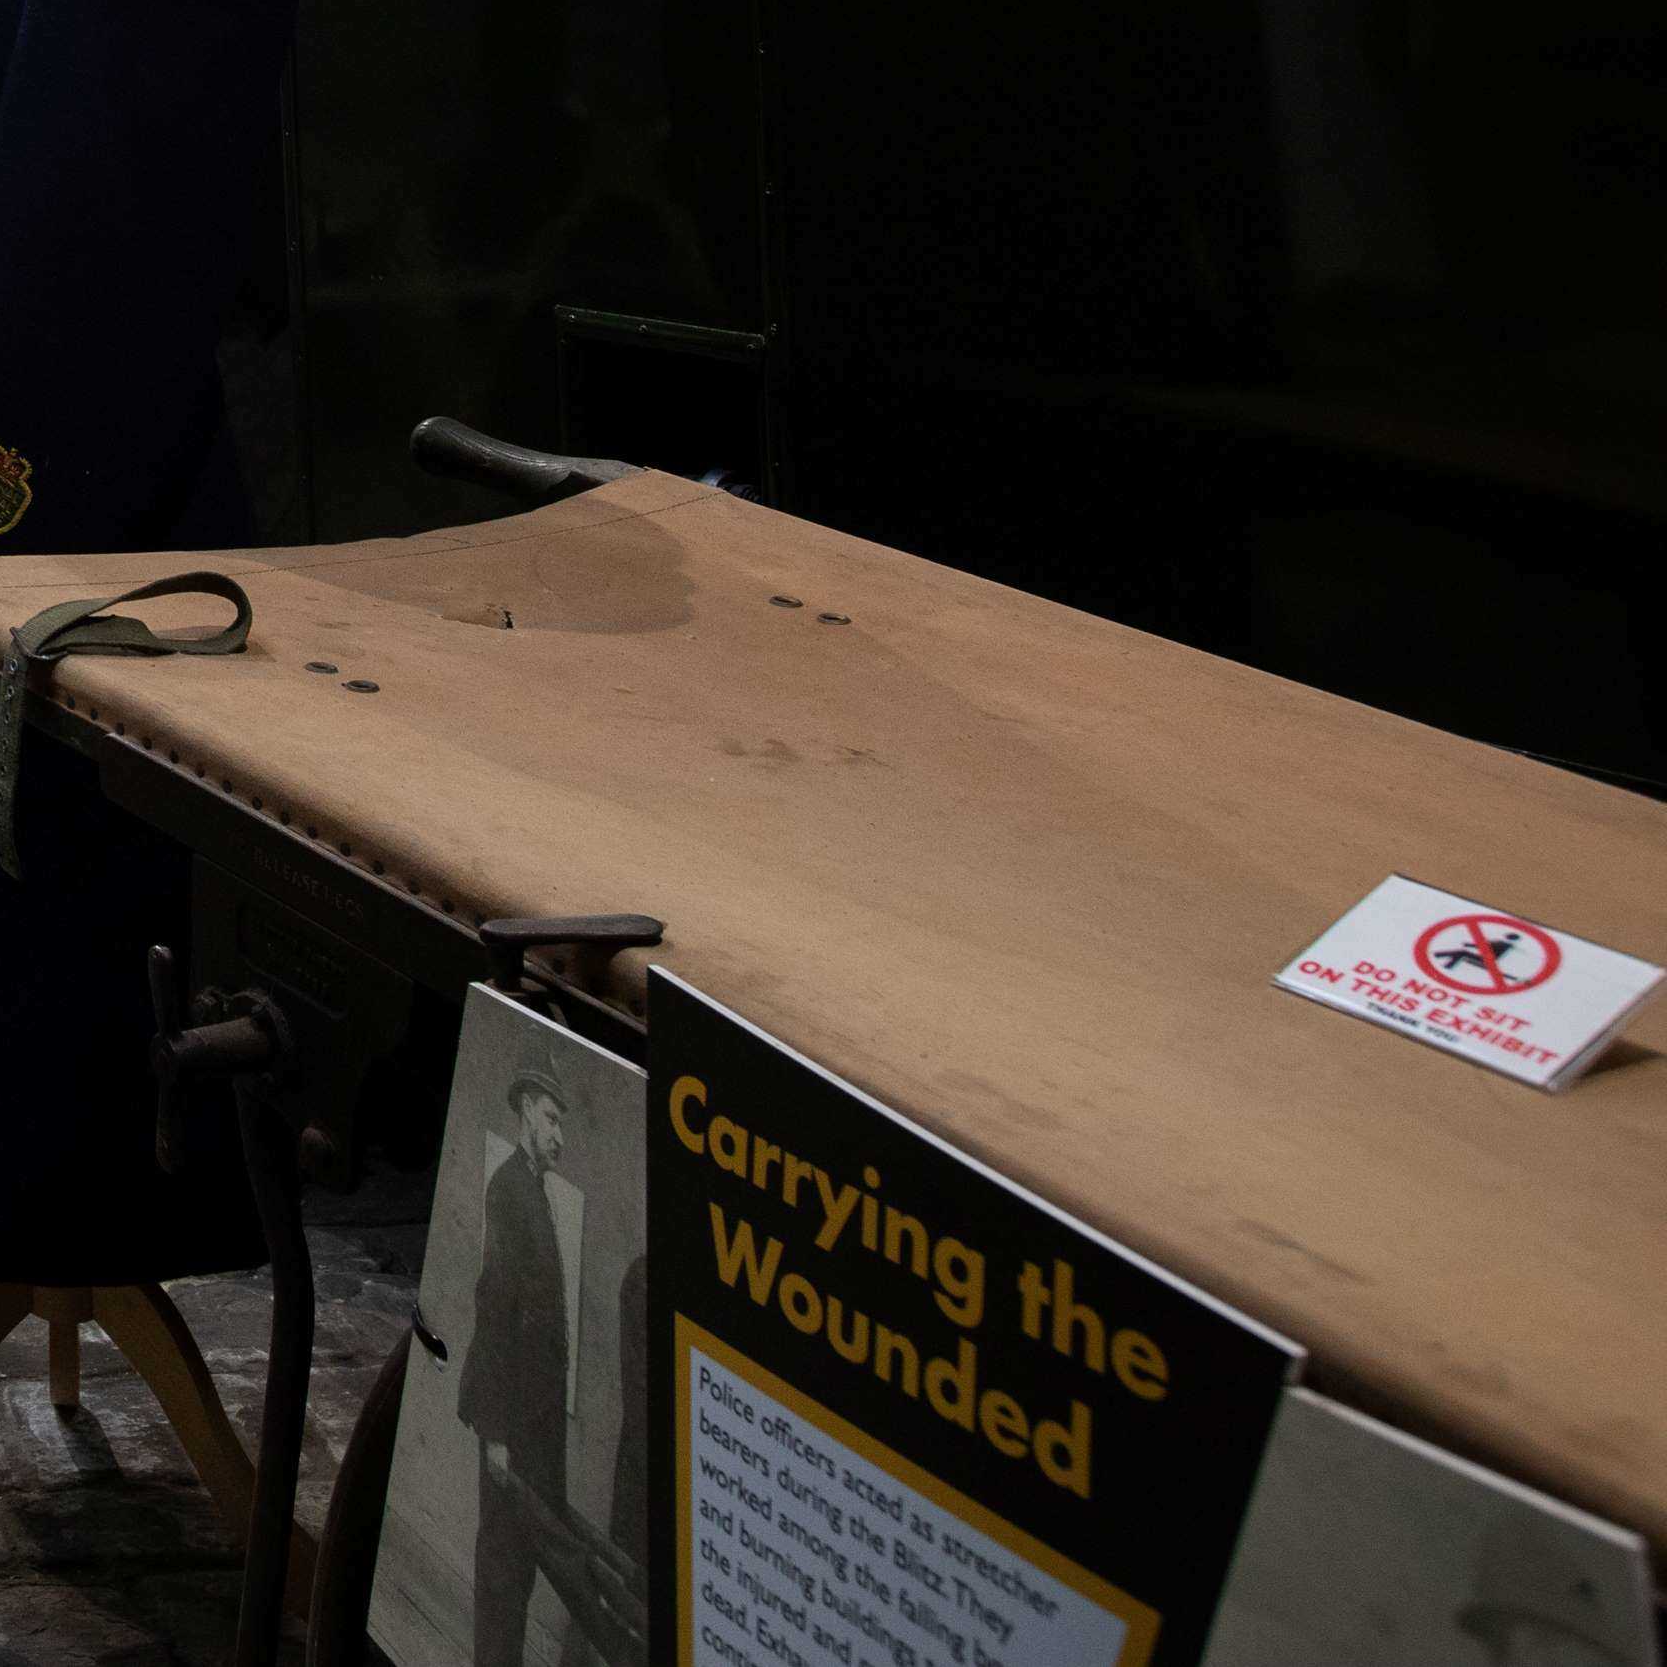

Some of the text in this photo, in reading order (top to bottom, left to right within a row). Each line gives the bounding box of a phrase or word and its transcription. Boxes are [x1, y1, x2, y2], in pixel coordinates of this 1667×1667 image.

[1298, 960, 1561, 1067] ON THIS EXHIBIT
[1353, 959, 1532, 1033] DO NOT SIT
[669, 1075, 1168, 1400] Carrying the
[709, 1201, 1092, 1500] Wounded
[700, 1366, 1059, 1618] Police officers acted as stretcher
[700, 1407, 1015, 1646] bearers during the Blitz. They
[700, 1454, 771, 1522] worked
[778, 1510, 848, 1584] among
[854, 1560, 892, 1605] the
[898, 1586, 965, 1662] falling
[700, 1497, 916, 1667] and burning buildings
[700, 1538, 852, 1667] the injured and
[701, 1580, 751, 1634] dead.
